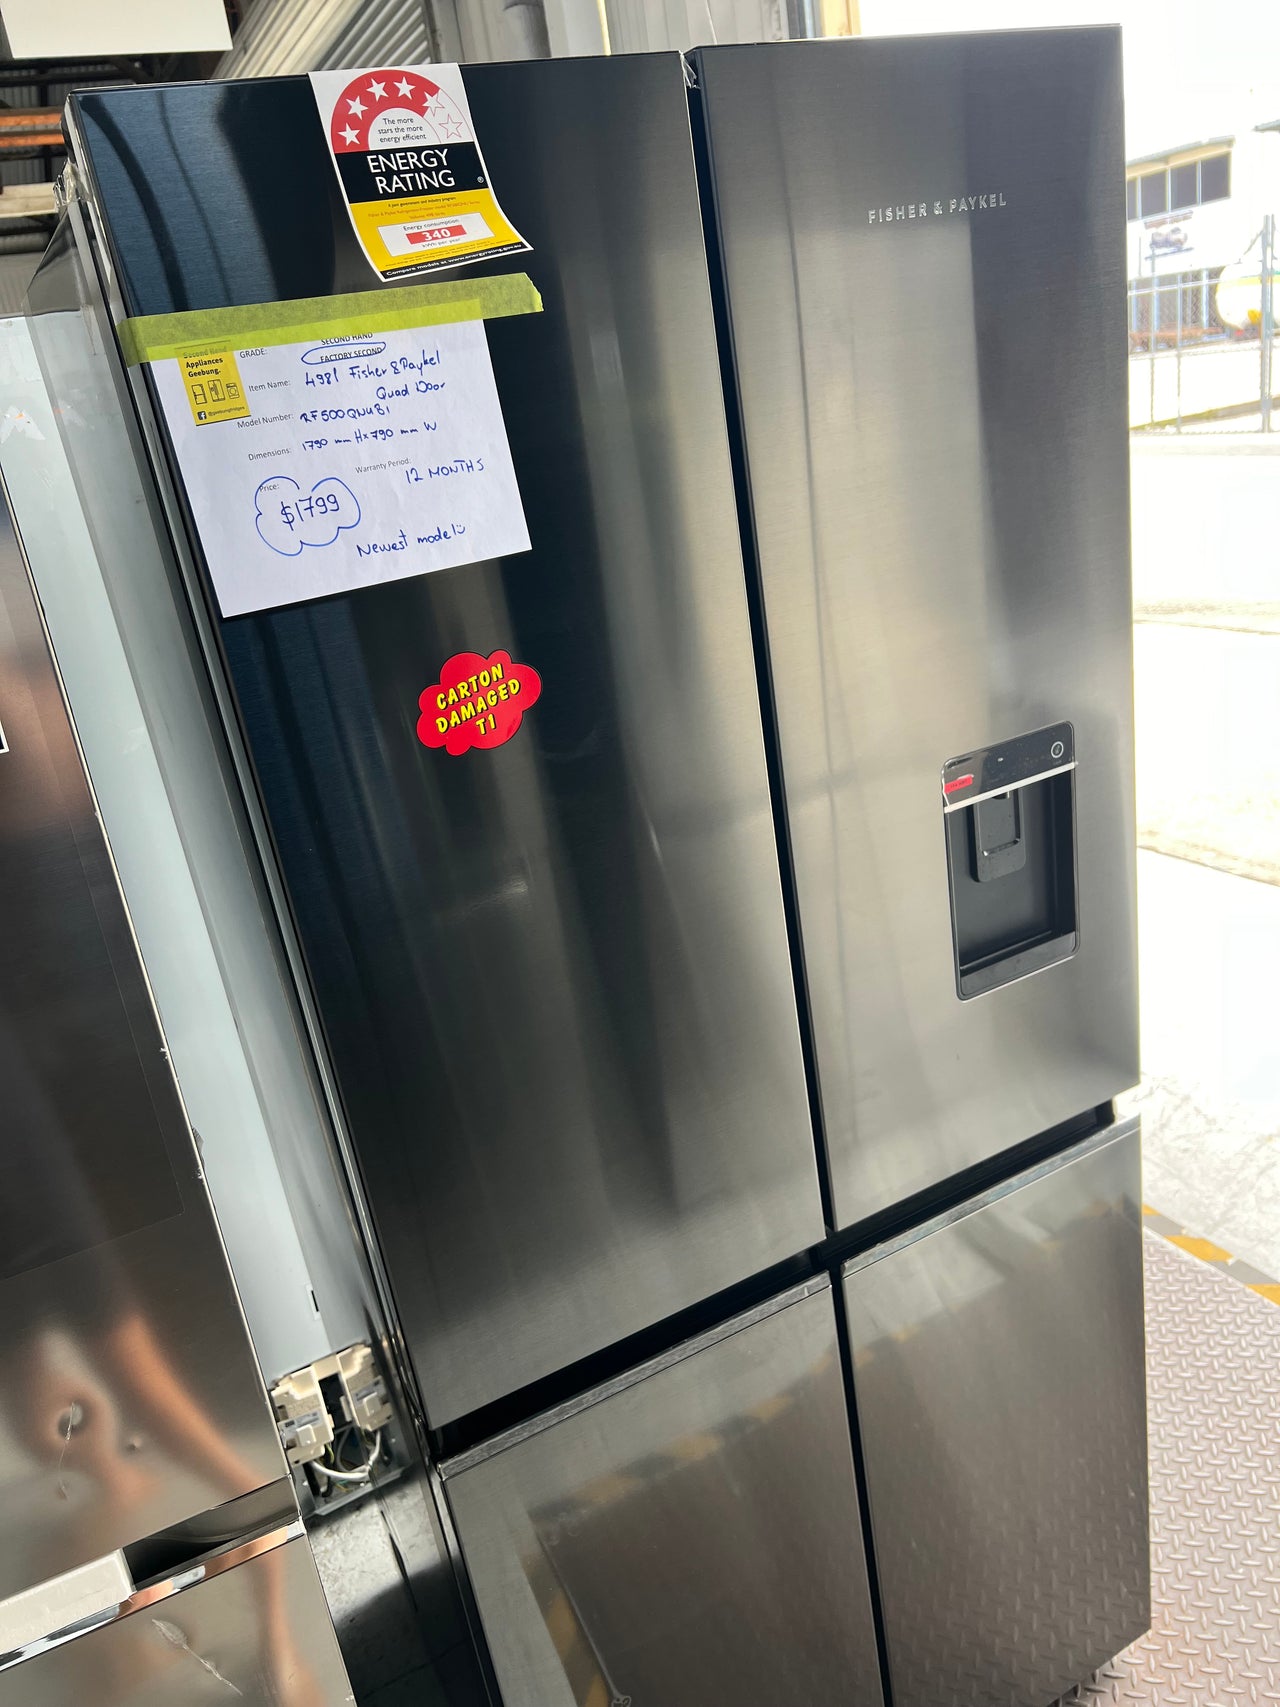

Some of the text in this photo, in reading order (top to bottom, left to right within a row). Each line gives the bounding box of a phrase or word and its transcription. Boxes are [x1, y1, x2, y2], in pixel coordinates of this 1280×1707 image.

[383, 117, 396, 126] The
[378, 126, 393, 134] stars
[394, 126, 405, 134] the
[380, 133, 426, 144] energy efficient
[367, 148, 449, 174] ENERGY
[375, 170, 456, 194] RATING
[868, 192, 1007, 224] FISHER & PAYKEL
[403, 219, 460, 232] Energy consumption
[422, 228, 450, 241] 340
[386, 266, 416, 276] Compare
[418, 262, 440, 270] models
[448, 244, 522, 262] www.energyrating.gov.au
[321, 336, 350, 346] SECOND
[240, 348, 267, 358] GRADE:
[320, 346, 382, 362] FACTORY SECOND
[186, 358, 224, 370] Appliances
[349, 364, 388, 380] Fisher
[188, 368, 221, 378] Geebung.
[248, 380, 290, 392] Item Name:
[376, 380, 446, 400] Quad Door
[237, 414, 294, 428] Model Number:
[302, 438, 328, 452] 1790
[400, 428, 418, 436] mm
[424, 421, 437, 432] W
[248, 447, 292, 461] Dimensions:
[355, 458, 412, 474] Warranty Period:
[404, 458, 485, 484] 12 MONTHS
[258, 483, 280, 492] Price:
[280, 493, 340, 532] $1799
[356, 528, 408, 558] Newest
[436, 663, 504, 710] CARTON
[436, 678, 520, 734] DAMAGED
[476, 714, 496, 735] T1
